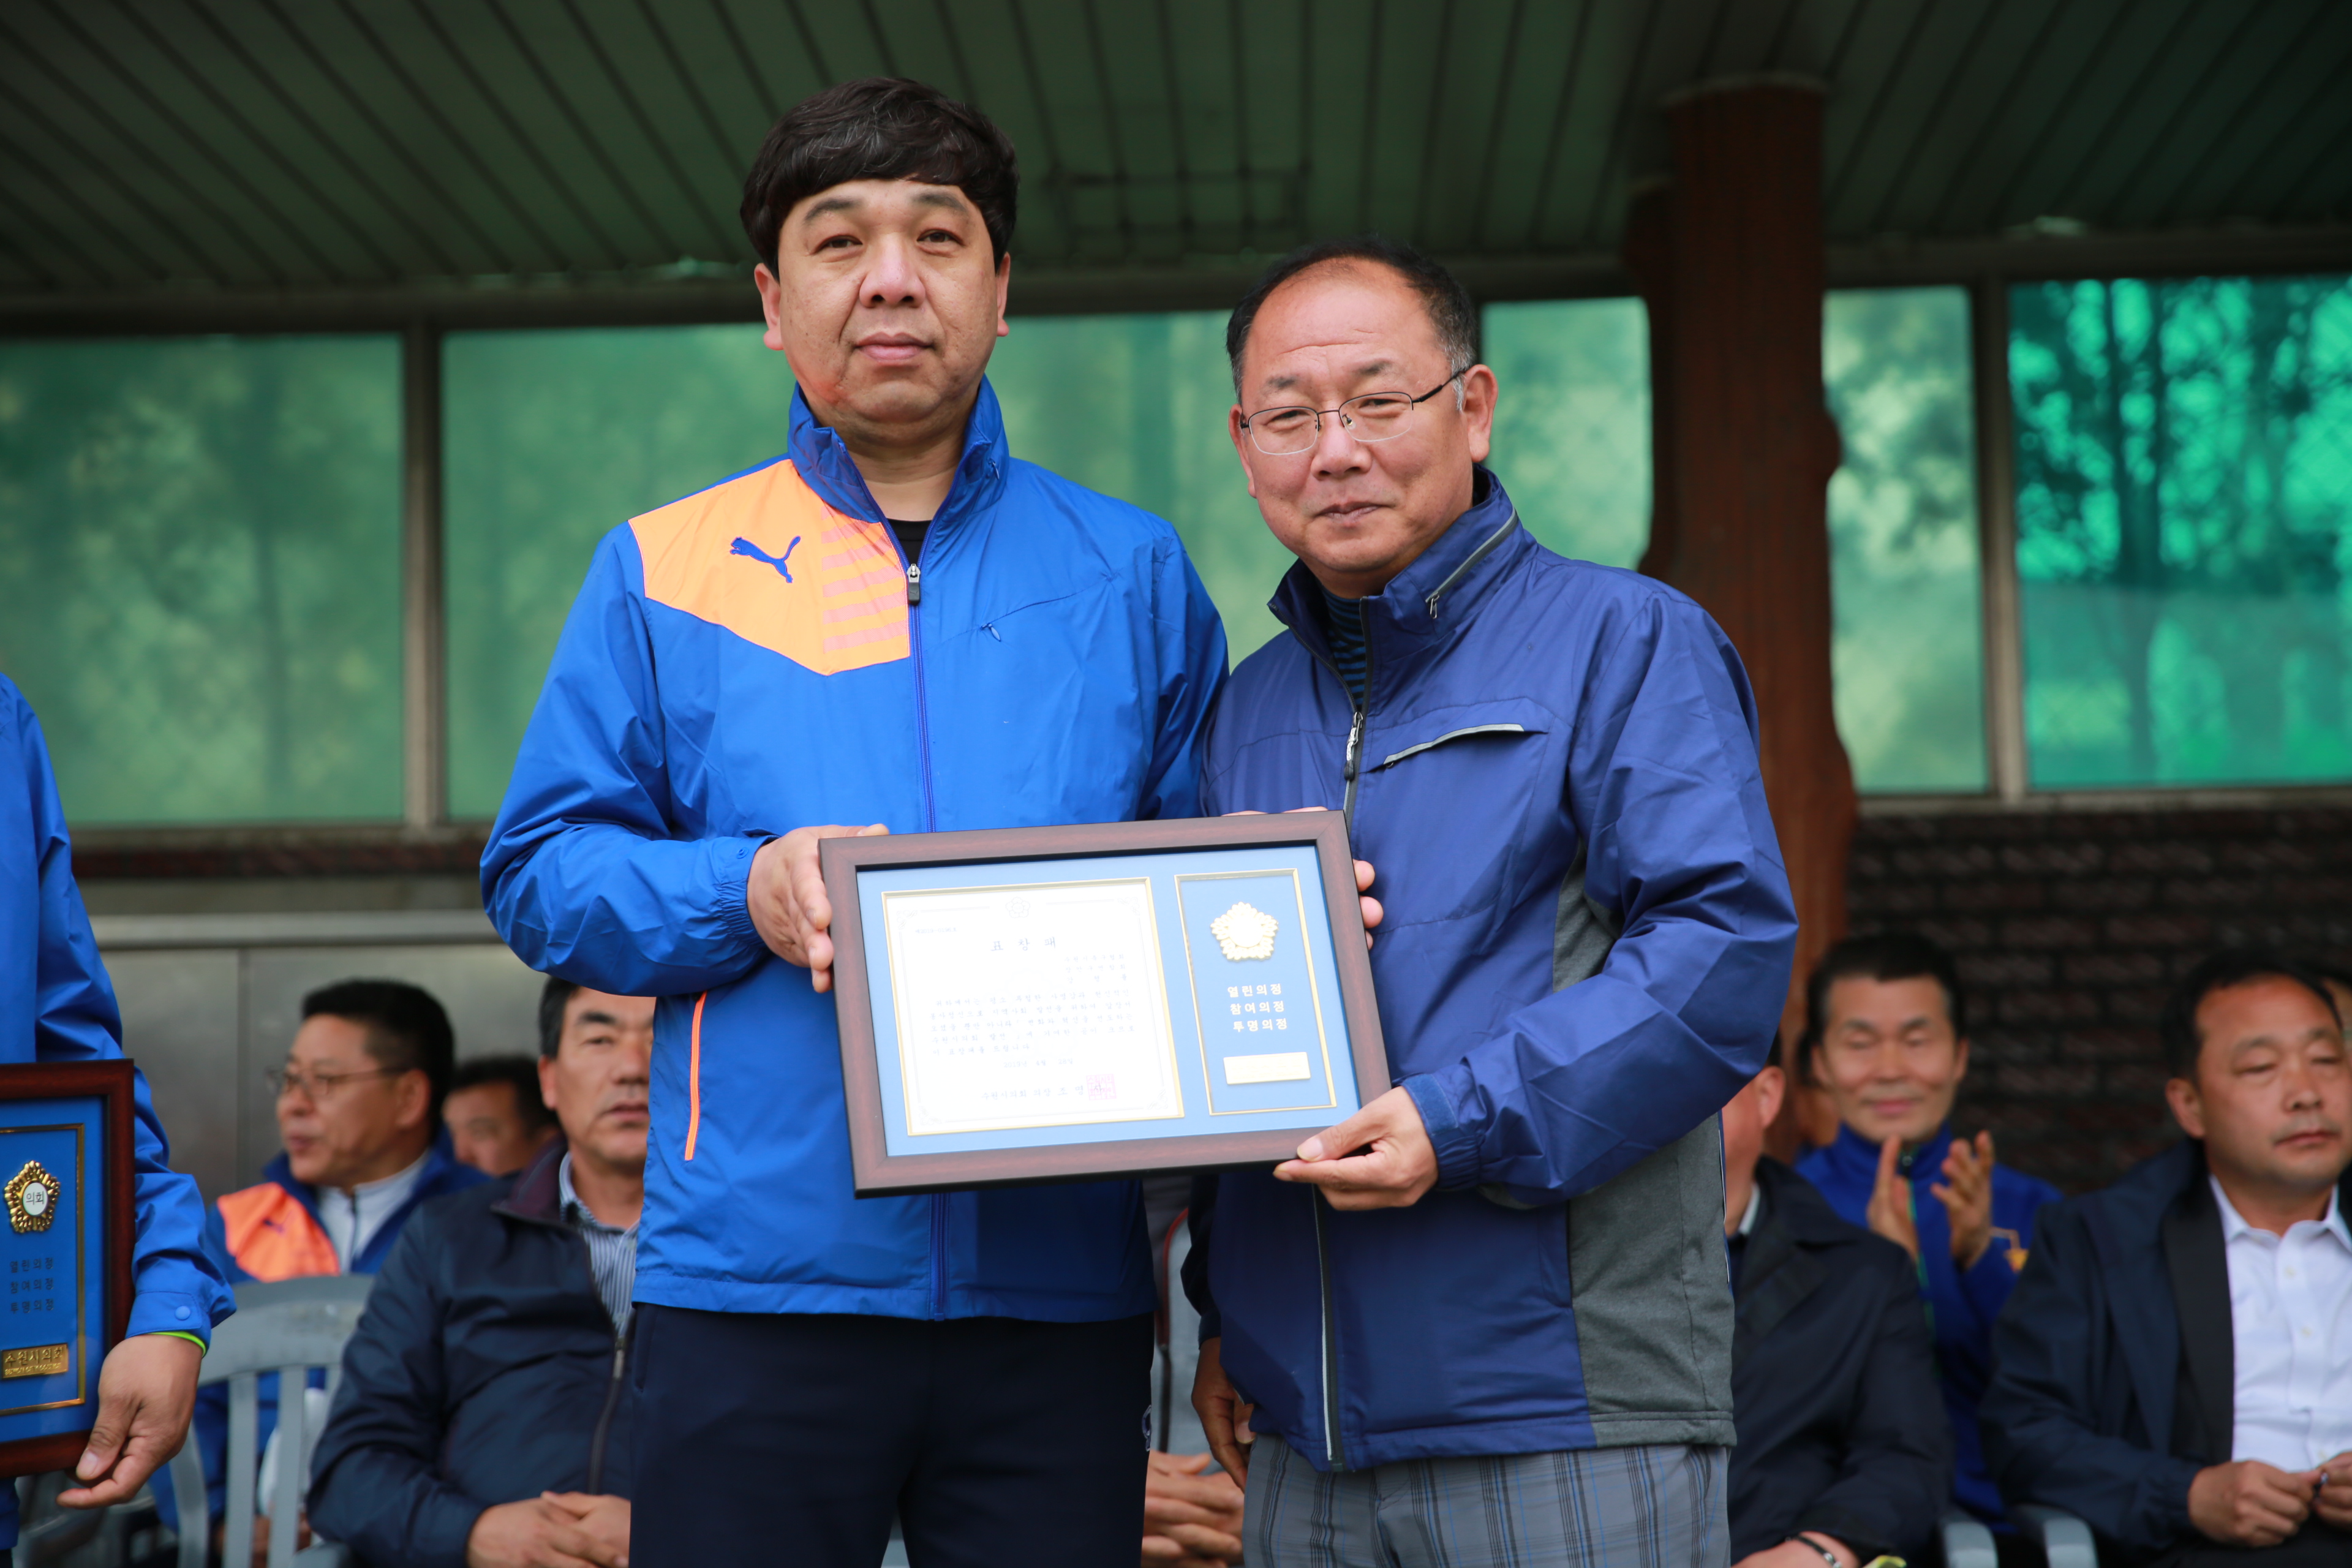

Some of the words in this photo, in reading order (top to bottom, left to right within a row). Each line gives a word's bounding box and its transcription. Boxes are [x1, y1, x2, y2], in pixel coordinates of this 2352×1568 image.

[1227, 982, 1282, 998] 열린의정
[1230, 1000, 1284, 1016] 참여의정
[1233, 1017, 1287, 1033] 투명의정
[932, 1034, 979, 1044] 수원시의회
[981, 1088, 1027, 1100] 수원시의회
[1033, 1087, 1051, 1098] 의장
[26, 1190, 44, 1205] 의회
[10, 1257, 54, 1273] 열린의정
[10, 1278, 54, 1294] 참여의정
[11, 1298, 54, 1314] 투명의정
